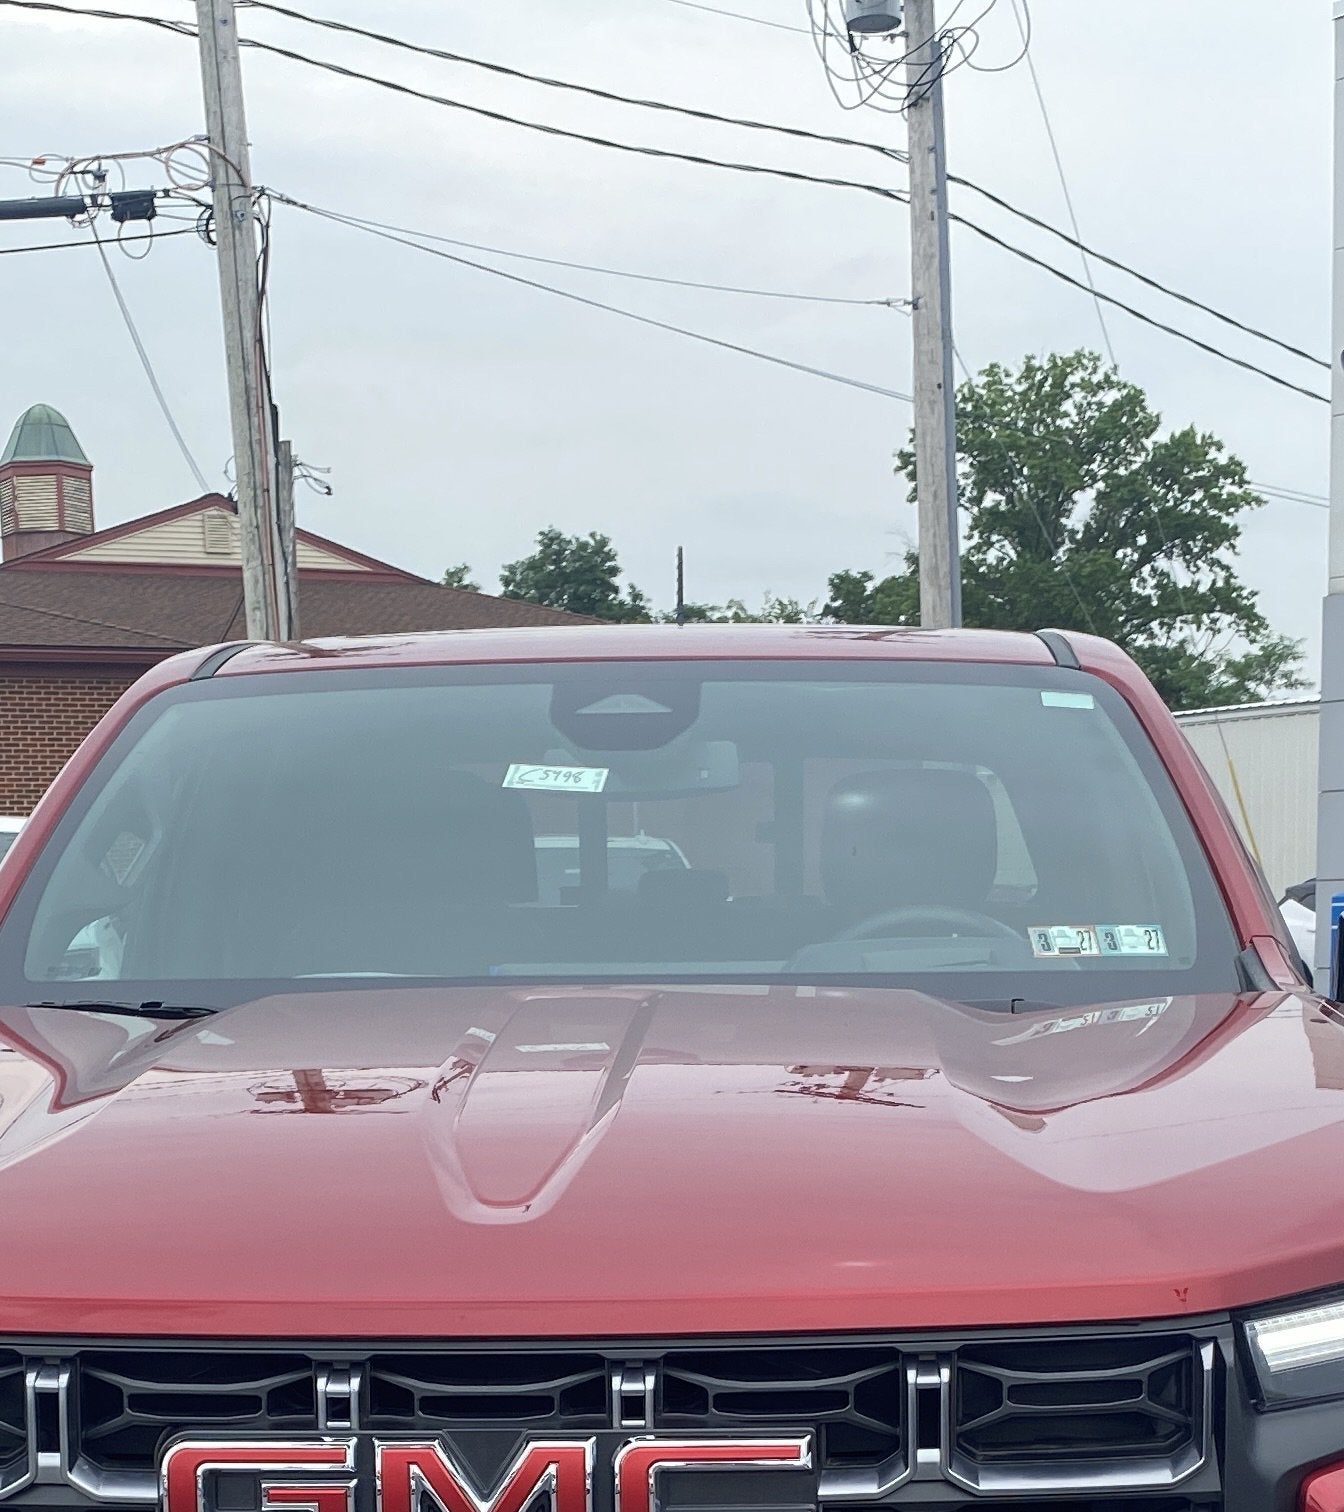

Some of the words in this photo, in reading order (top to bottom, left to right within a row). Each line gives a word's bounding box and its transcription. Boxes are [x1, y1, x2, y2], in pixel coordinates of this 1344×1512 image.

[1038, 933, 1052, 951] 3
[1077, 930, 1093, 951] 27
[1105, 931, 1118, 951] 3
[1144, 929, 1160, 951] 27
